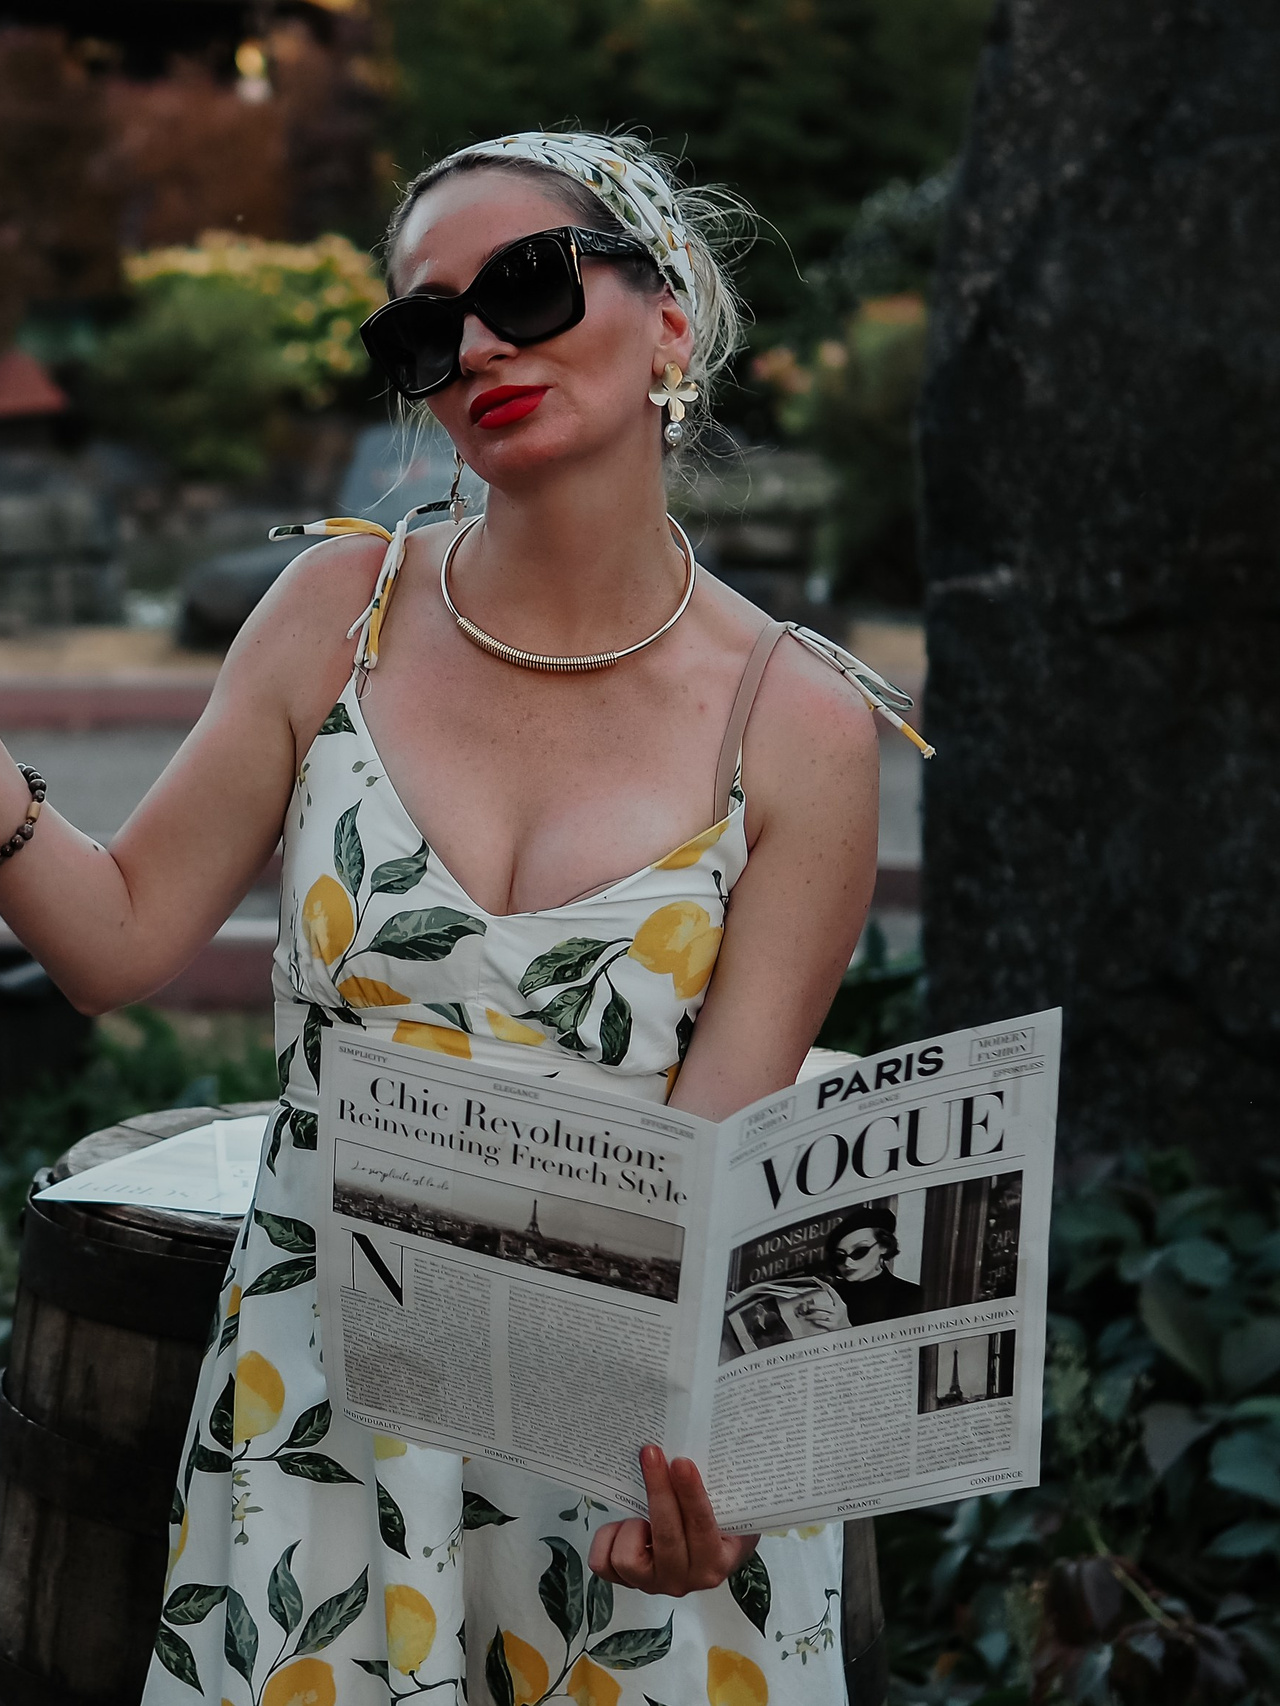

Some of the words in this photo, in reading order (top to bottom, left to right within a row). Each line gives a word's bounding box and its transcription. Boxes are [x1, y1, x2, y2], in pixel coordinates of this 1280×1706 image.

[338, 1046, 388, 1064] SIMPLICITY
[816, 1045, 945, 1110] PARIS
[492, 1082, 540, 1100] ELEGANCE
[370, 1077, 449, 1121] Chic
[464, 1098, 666, 1172] Revolution:
[640, 1117, 694, 1140] EFFORTLESS
[338, 1098, 501, 1168] Reinventing
[511, 1143, 608, 1187] French
[618, 1168, 688, 1206] Style
[754, 1090, 1005, 1210] VOGUE
[749, 1245, 825, 1283] OMELETT
[899, 1325, 925, 1337] WITH
[927, 1315, 971, 1332] PARISIAN
[343, 1407, 402, 1431] INDIVIDUALITY
[484, 1448, 528, 1466] ROMANTIC
[970, 1470, 1024, 1486] CONFIDENCE
[836, 1497, 881, 1513] ROMANTIC
